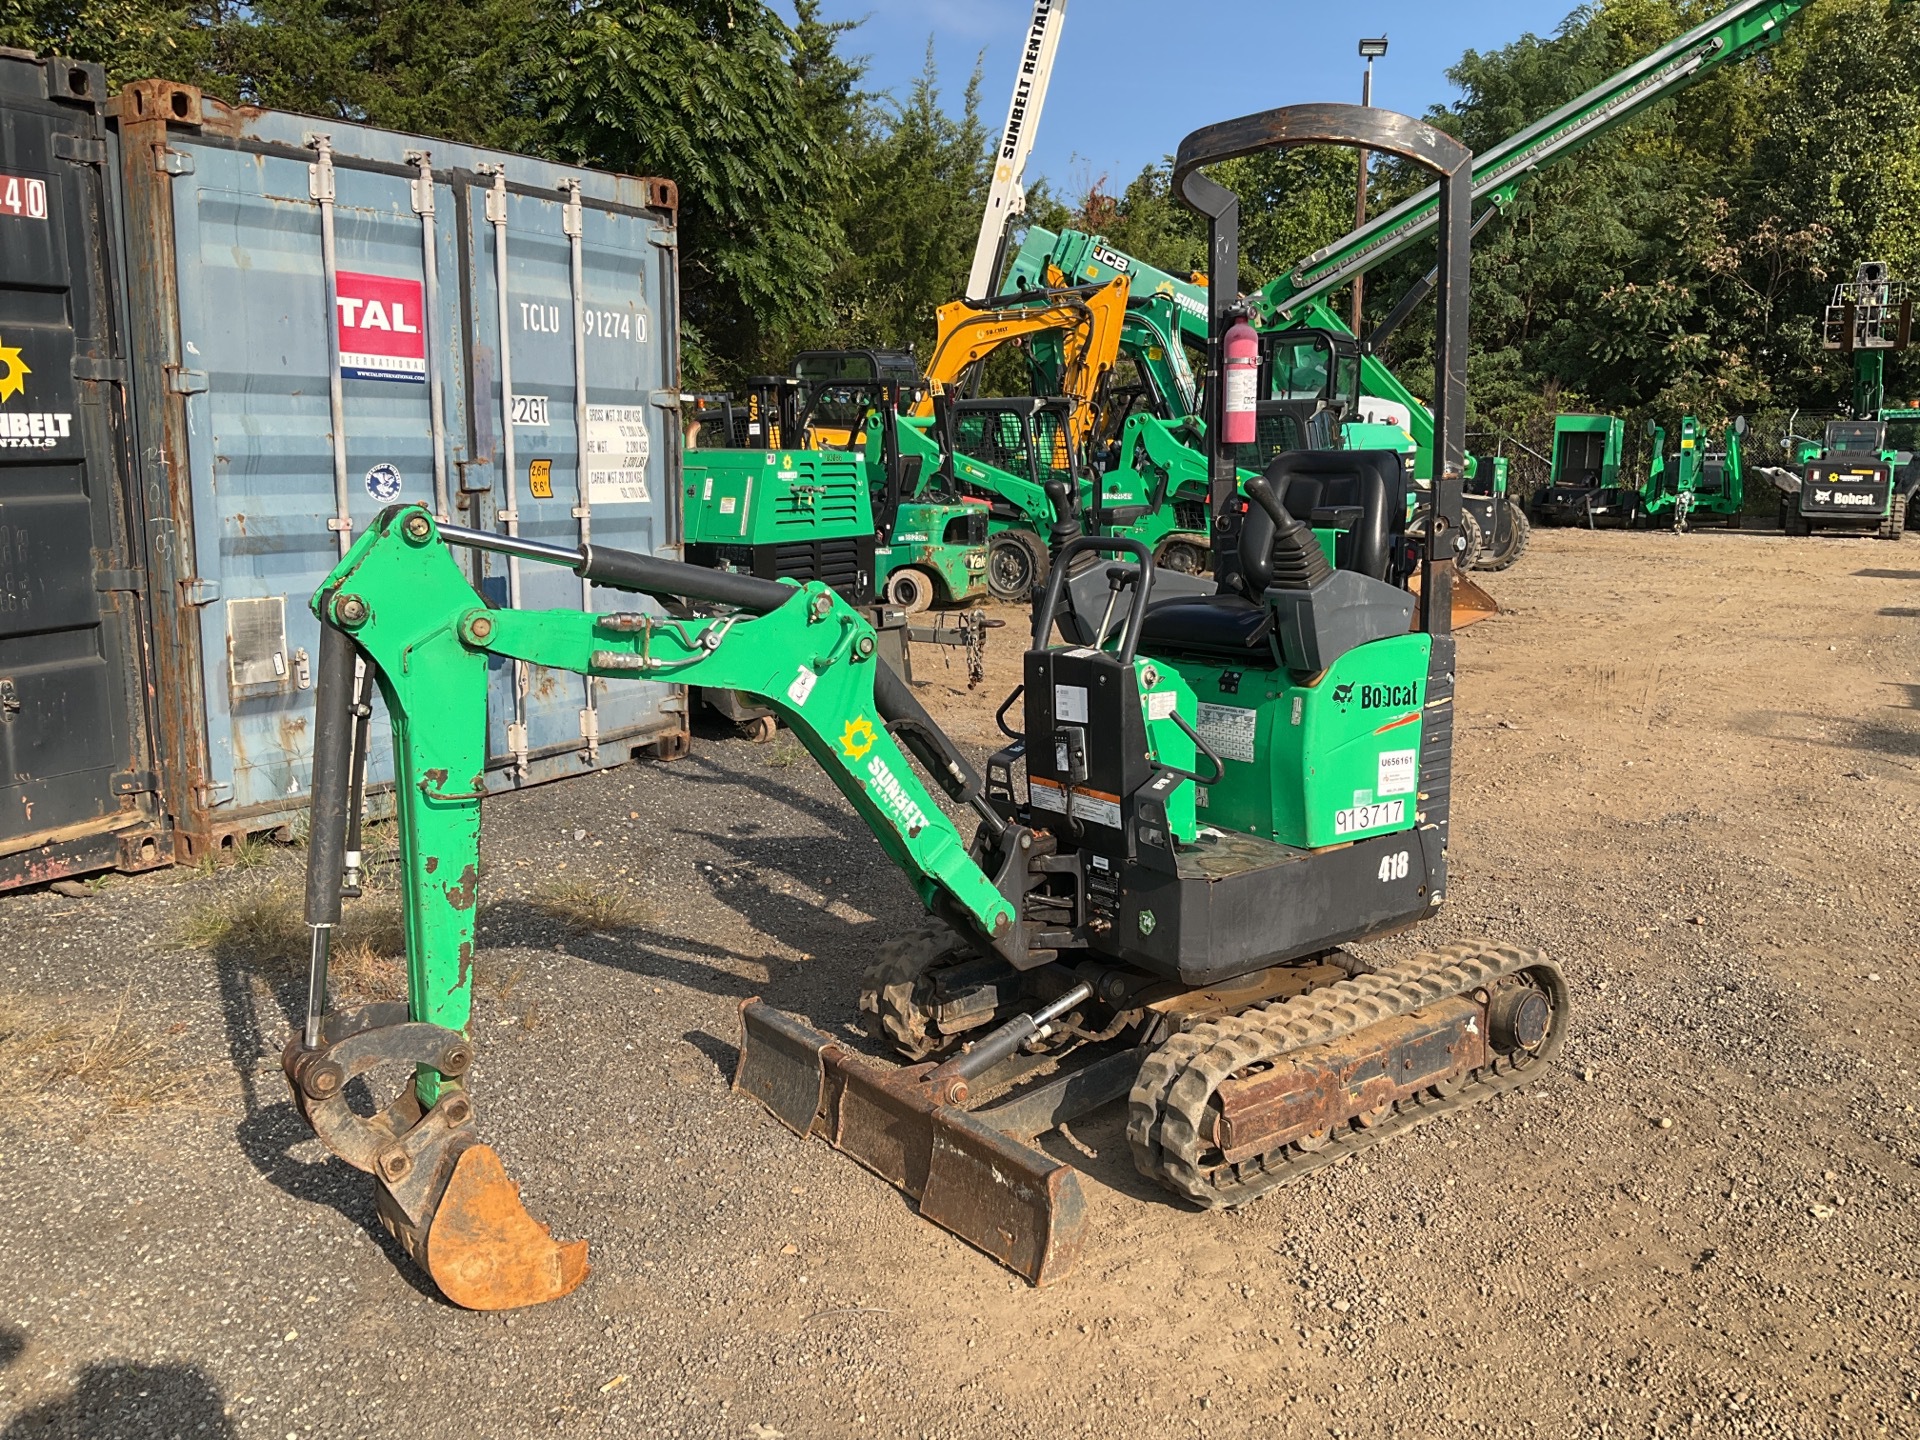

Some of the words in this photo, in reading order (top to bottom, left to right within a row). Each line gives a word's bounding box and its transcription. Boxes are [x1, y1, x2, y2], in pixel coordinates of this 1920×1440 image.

[1002, 78, 1031, 160] SUNBELT
[1092, 247, 1129, 272] JCB
[520, 302, 560, 333] TCLU
[749, 394, 758, 422] Yale
[1361, 681, 1417, 709] Bobcat
[1381, 756, 1412, 767] U656161
[868, 755, 930, 829] SUNBELT
[1336, 800, 1402, 831] 913717
[1378, 850, 1409, 882] 418
